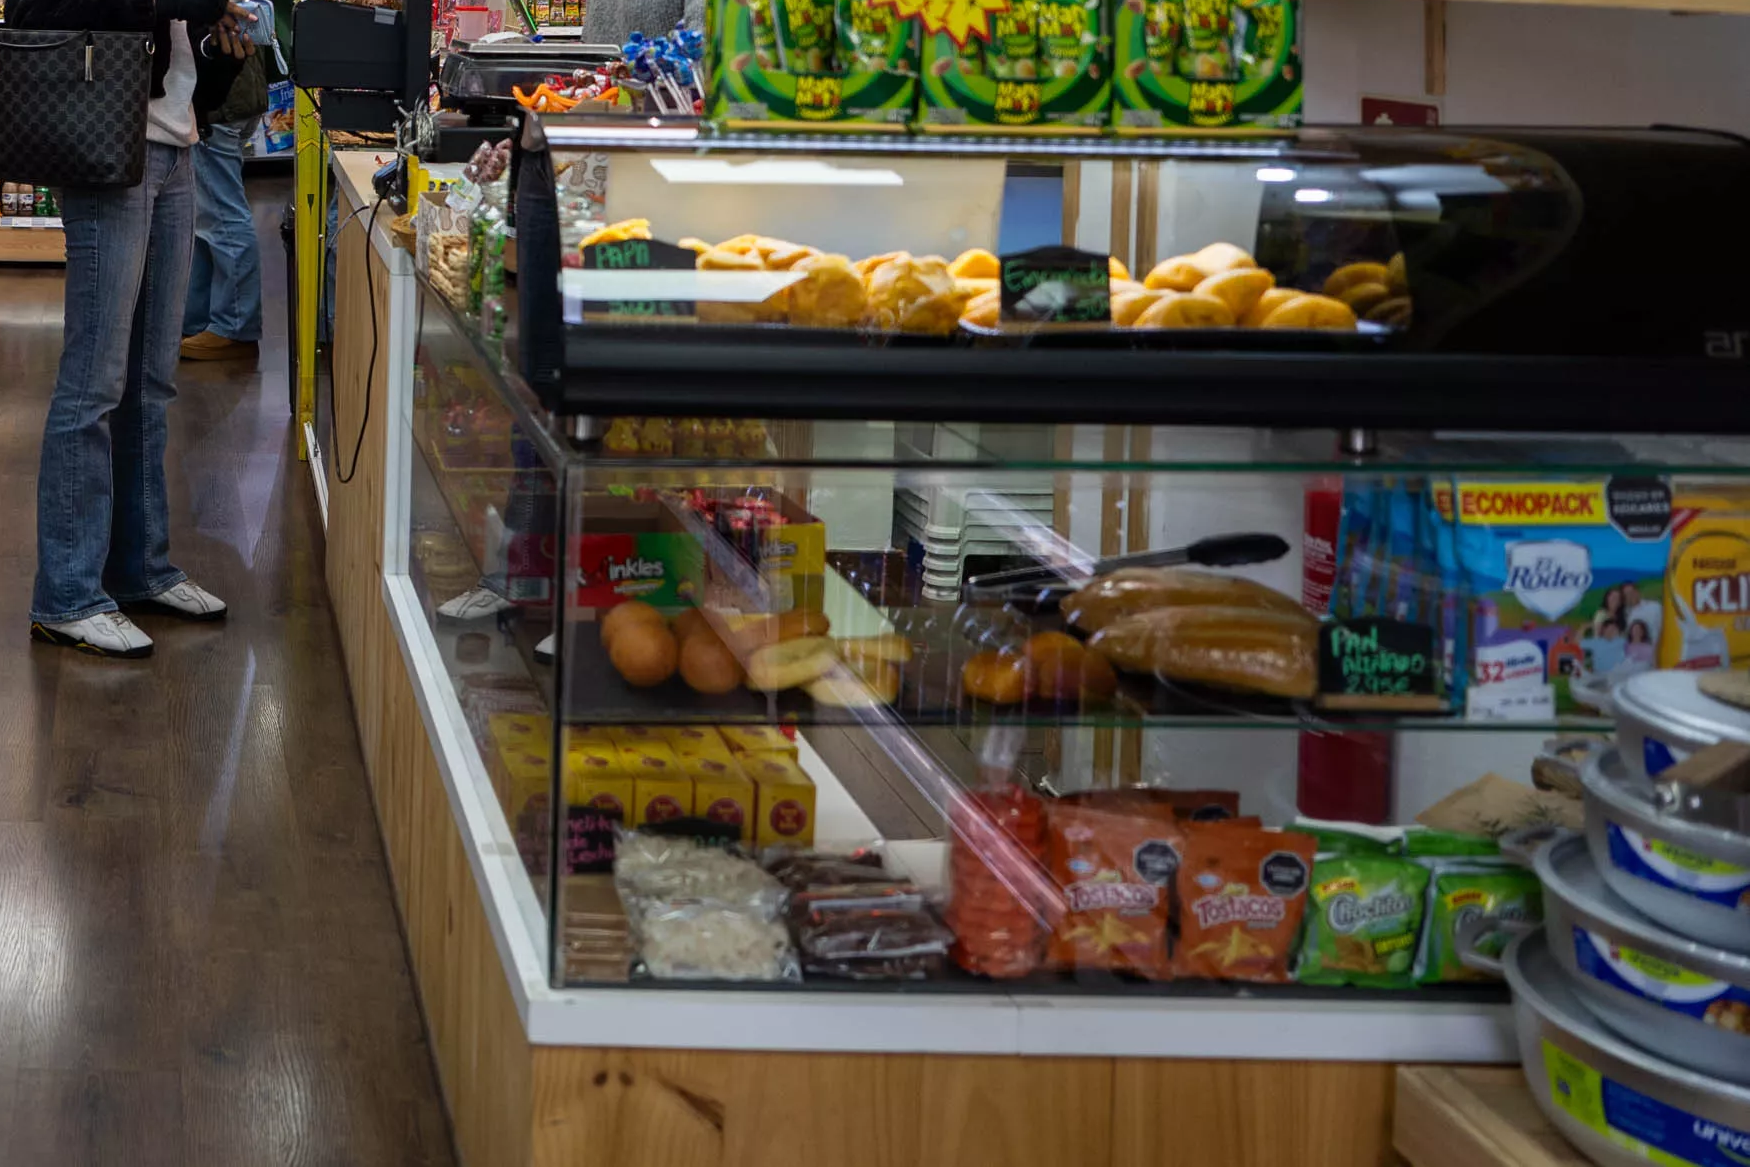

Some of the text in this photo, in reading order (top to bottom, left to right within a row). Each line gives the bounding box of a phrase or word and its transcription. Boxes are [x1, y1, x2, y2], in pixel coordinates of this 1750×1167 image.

[1461, 491, 1594, 516] ECONOPACK
[1509, 566, 1590, 591] Rodeo
[1694, 574, 1750, 612] KLI
[1478, 659, 1506, 686] 32
